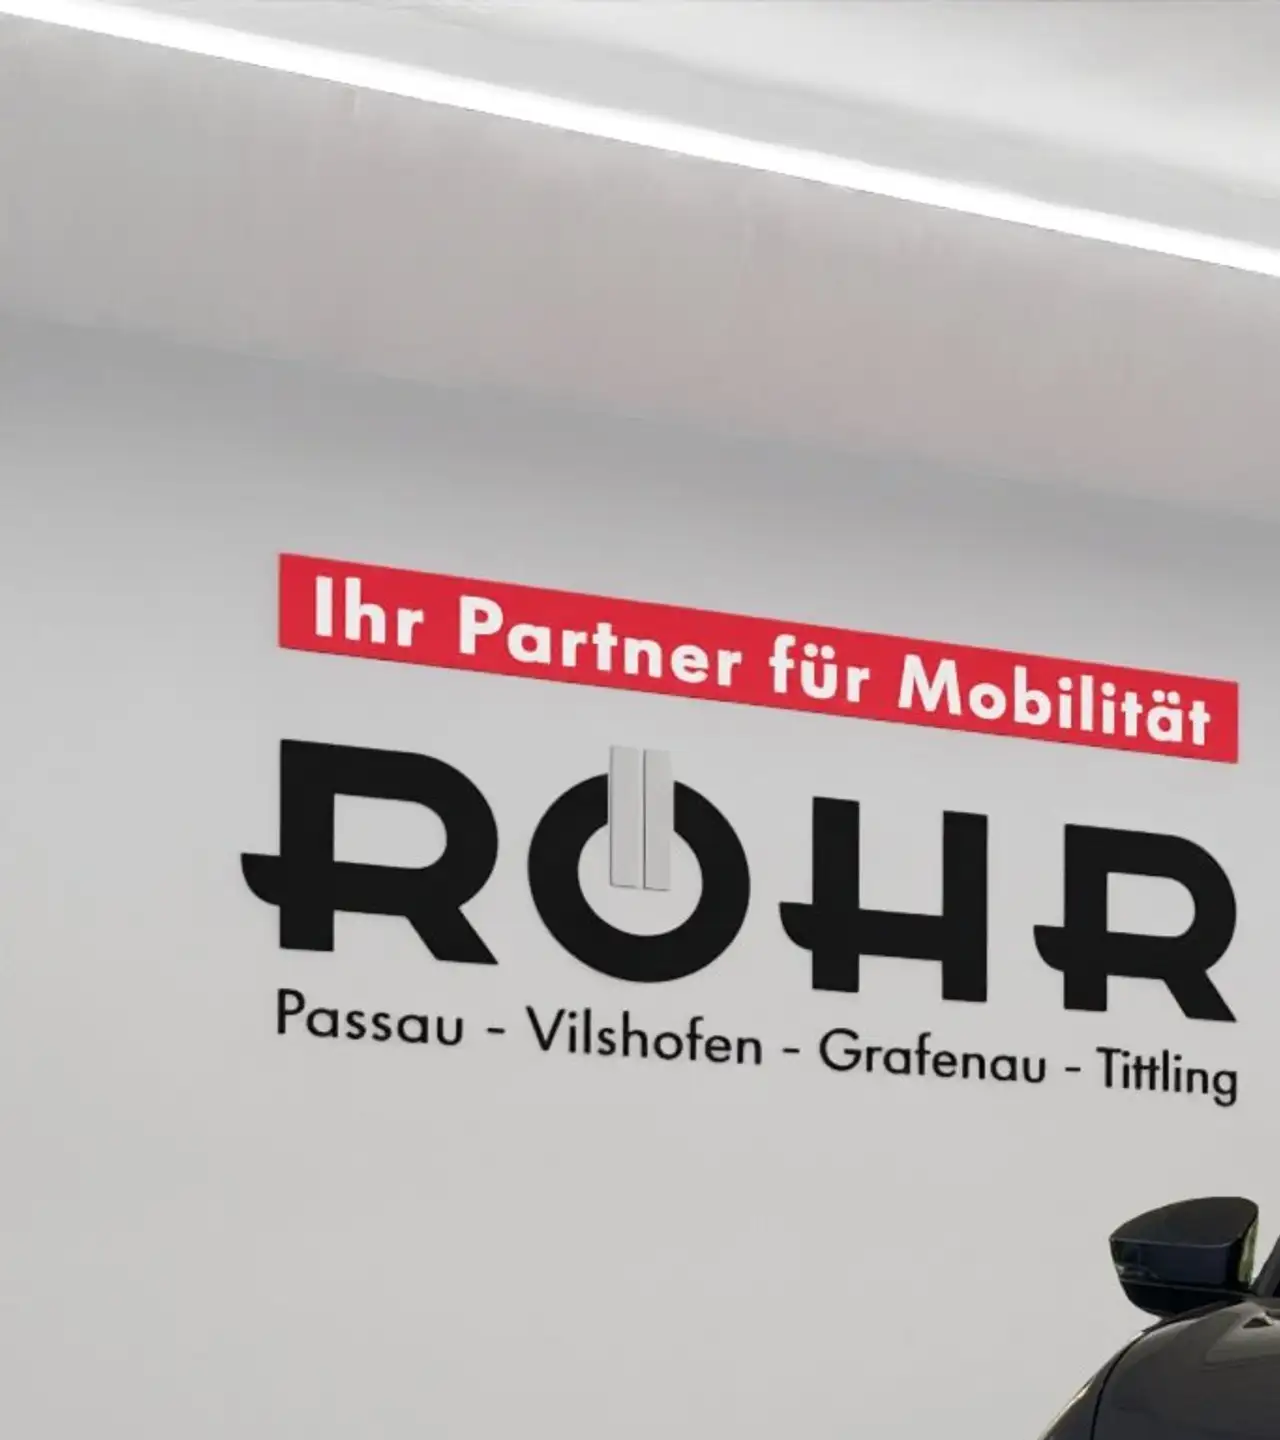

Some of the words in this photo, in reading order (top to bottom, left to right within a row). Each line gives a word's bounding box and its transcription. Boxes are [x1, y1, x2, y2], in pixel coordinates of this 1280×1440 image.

[314, 575, 424, 647] Ihr
[459, 594, 742, 688] Partner
[768, 634, 870, 703] für
[897, 654, 1212, 746] Mobilität
[240, 738, 1238, 1023] RÖHR
[277, 988, 463, 1046] Passau
[525, 1005, 762, 1065] Vilshofen
[819, 1027, 1046, 1085] Grafenau
[1095, 1046, 1238, 1108] Tittling
